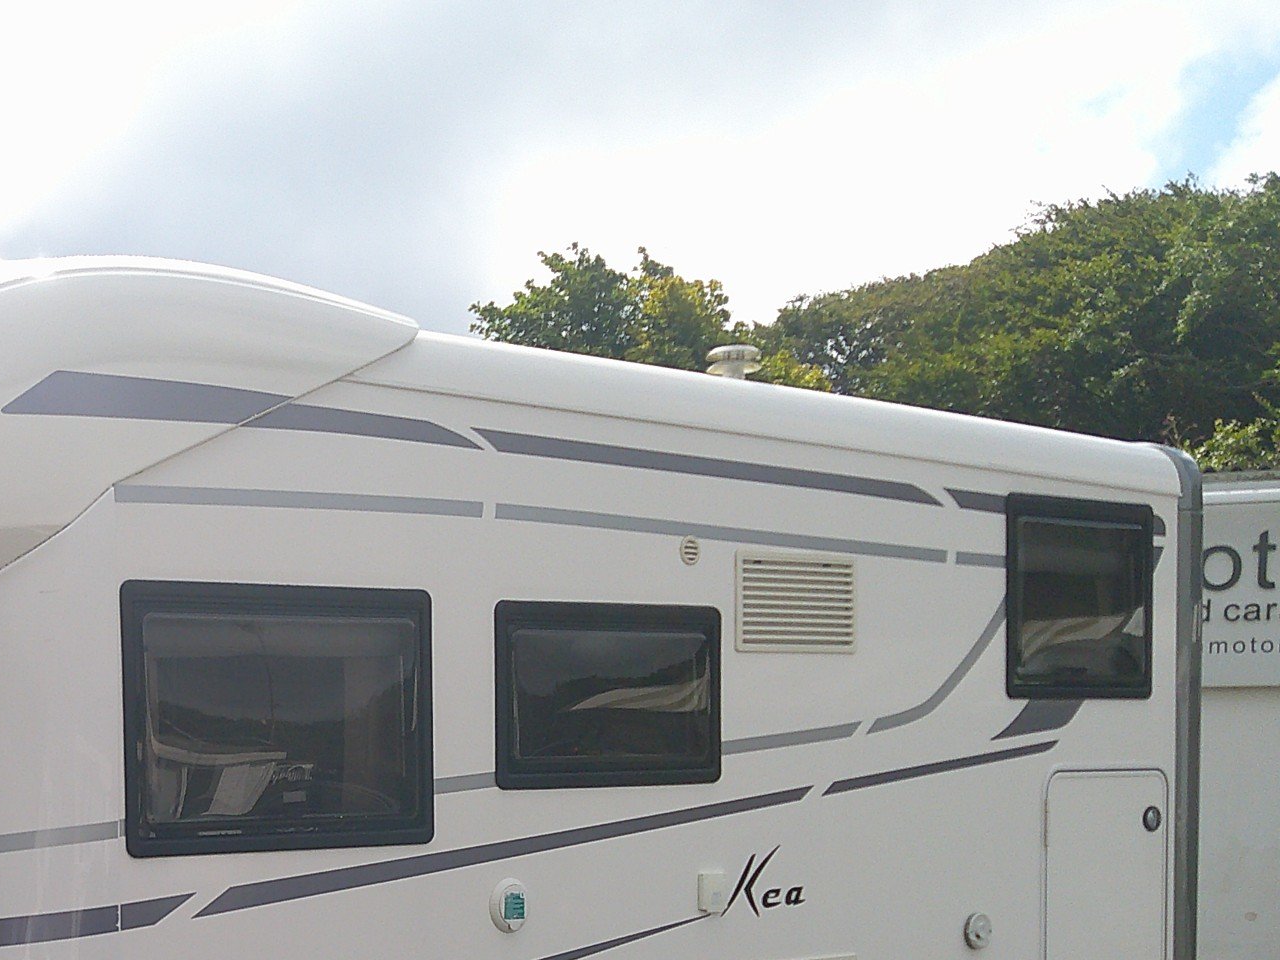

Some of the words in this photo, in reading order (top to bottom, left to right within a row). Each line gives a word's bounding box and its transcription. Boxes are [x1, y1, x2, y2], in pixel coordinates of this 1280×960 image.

[1224, 603, 1280, 622] car
[1209, 637, 1280, 654] moto
[721, 844, 806, 917] Kea
